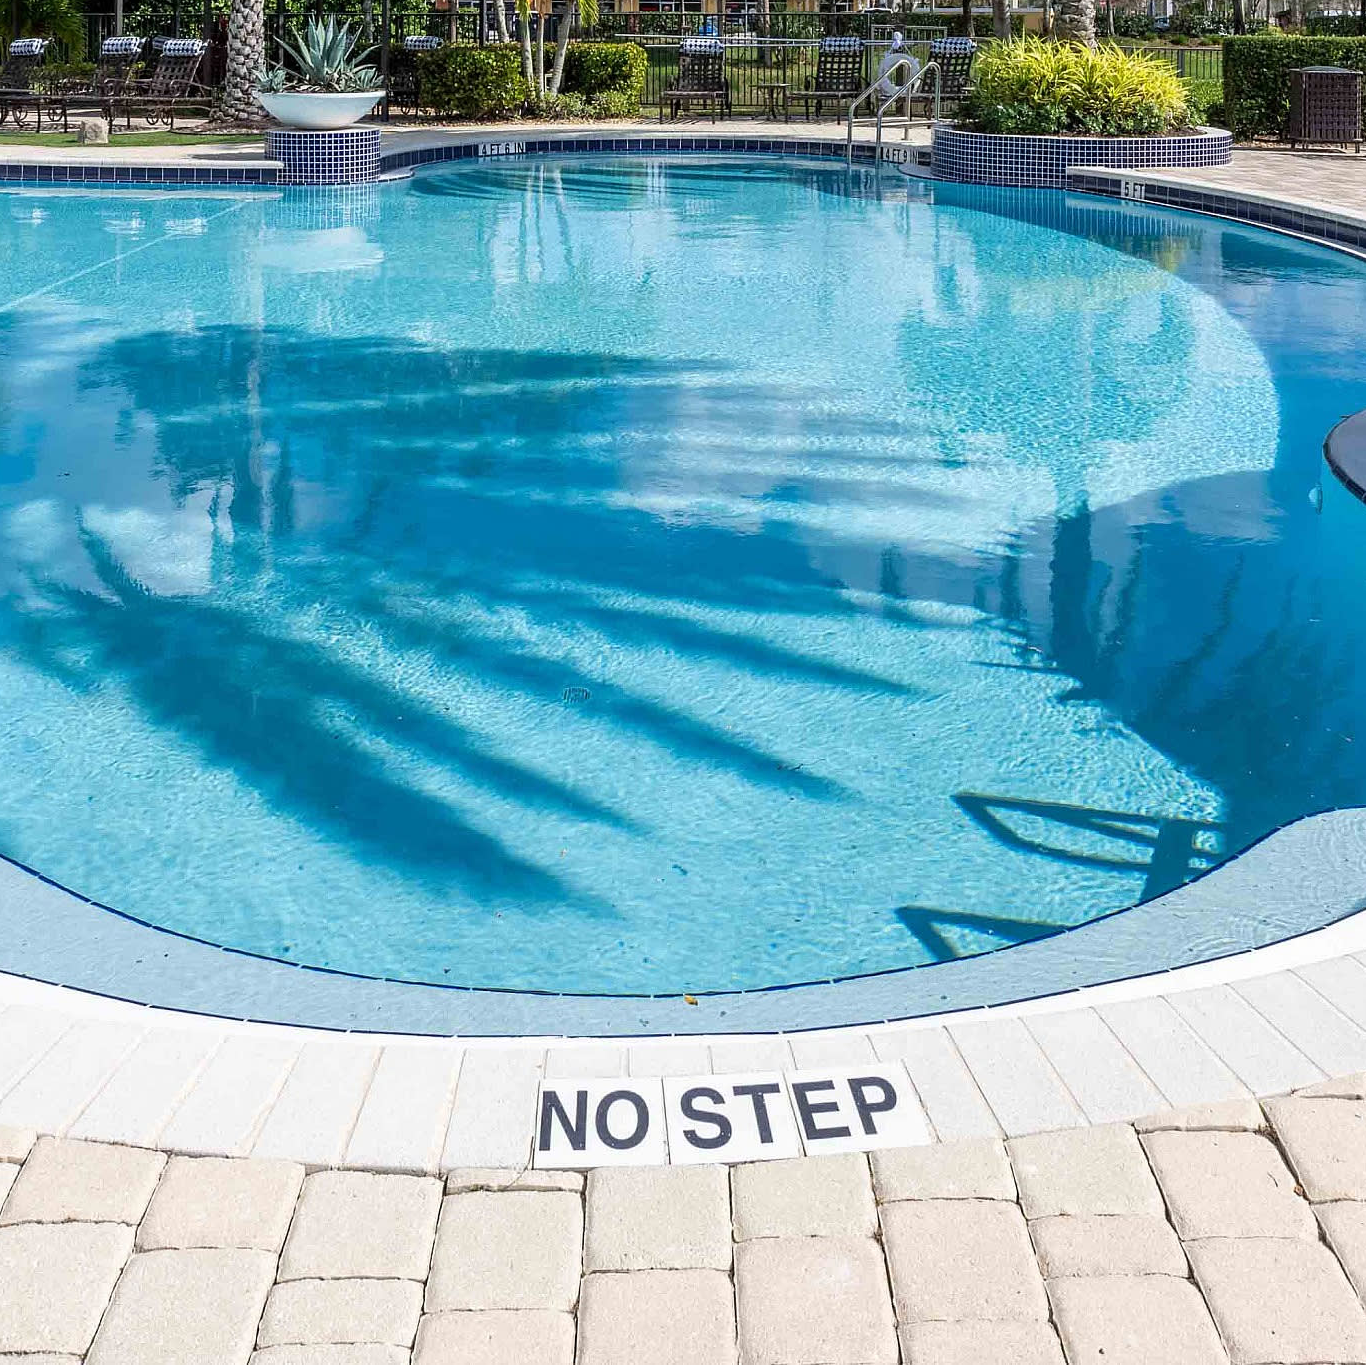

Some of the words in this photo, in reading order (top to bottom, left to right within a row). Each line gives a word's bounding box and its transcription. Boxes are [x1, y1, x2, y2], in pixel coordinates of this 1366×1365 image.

[481, 143, 487, 155] 4
[490, 143, 501, 155] FT
[505, 143, 510, 154] 6
[515, 142, 524, 154] IN
[892, 148, 901, 163] FT
[903, 149, 908, 163] 9
[909, 149, 918, 164] IN
[1125, 181, 1130, 197] 5
[1133, 182, 1145, 199] FT
[539, 1090, 649, 1152] NO
[680, 1076, 898, 1150] STEP
